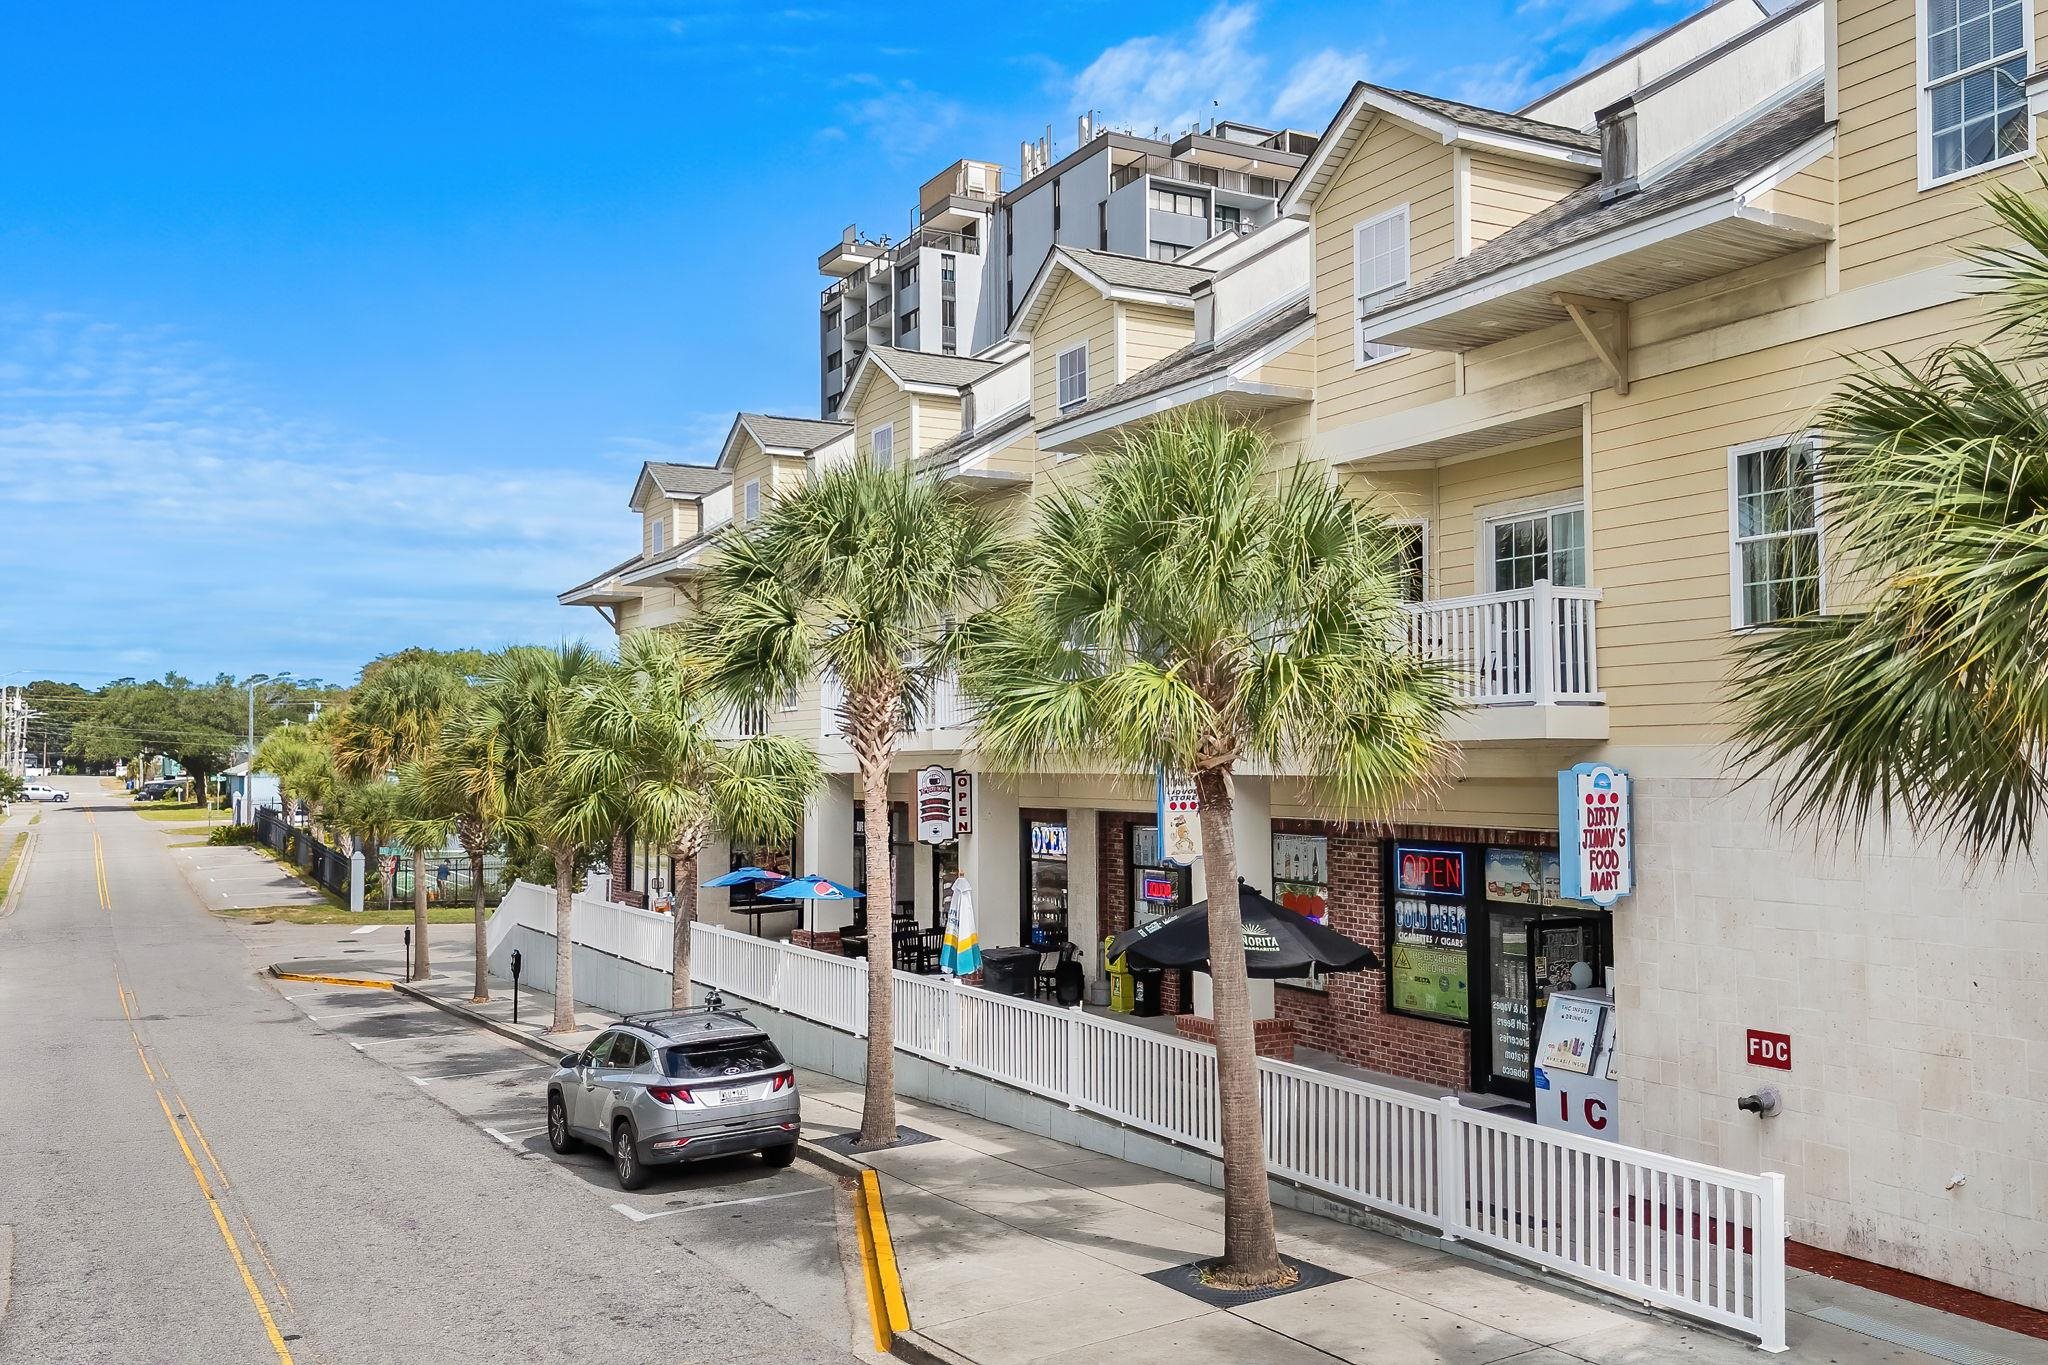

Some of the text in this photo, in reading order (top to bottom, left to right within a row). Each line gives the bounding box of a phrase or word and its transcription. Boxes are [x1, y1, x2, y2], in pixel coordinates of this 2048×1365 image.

[957, 777, 968, 831] OPEN
[1587, 806, 1619, 828] DIRTY
[1032, 826, 1067, 854] OPEN
[1582, 828, 1626, 849] JIMMY'S
[1403, 854, 1460, 888] OPEN
[1589, 849, 1620, 870] FOOD
[1590, 870, 1621, 892] MART
[1395, 901, 1467, 935] COLD BEER
[1397, 930, 1433, 945] CIGARETTES
[1440, 937, 1464, 948] CIGARS
[1750, 1037, 1788, 1062] FDC
